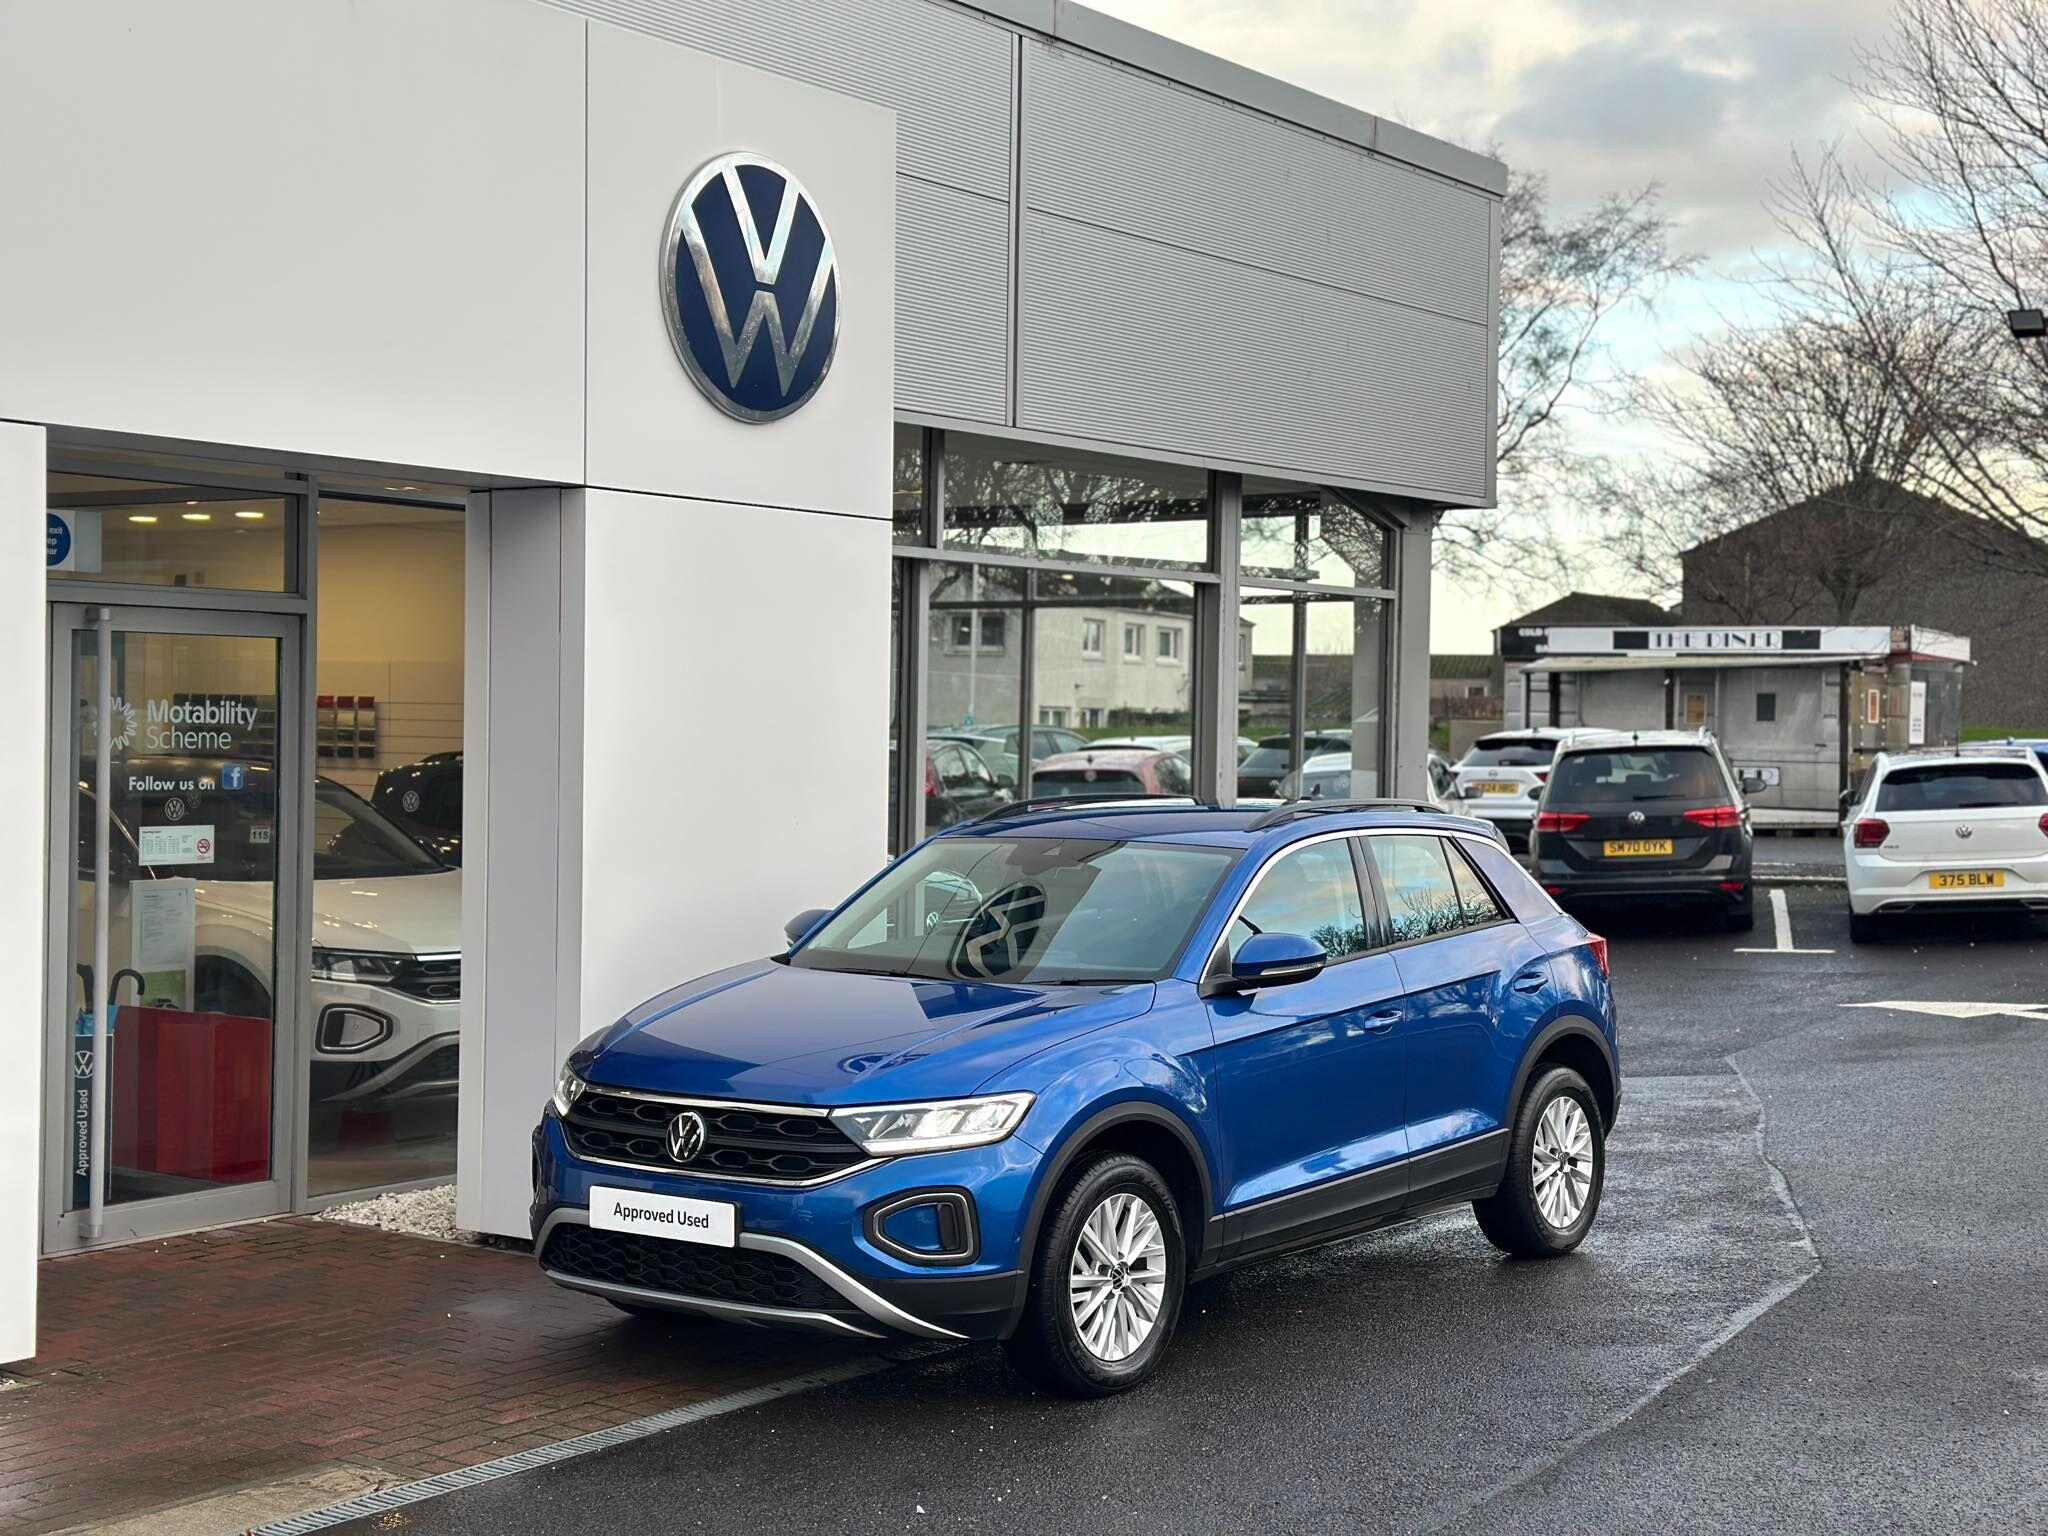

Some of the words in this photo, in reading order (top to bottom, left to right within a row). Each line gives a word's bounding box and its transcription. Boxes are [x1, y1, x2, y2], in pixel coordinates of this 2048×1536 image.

[659, 151, 842, 425] VW
[1706, 632, 1780, 648] DINER
[147, 699, 258, 731] Motability
[146, 725, 232, 749] Scheme
[128, 775, 175, 791] Follow
[180, 780, 194, 791] us
[198, 778, 216, 791] on
[252, 830, 269, 840] 115
[1938, 874, 1965, 887] 375
[1968, 873, 1994, 886] BLW
[77, 1089, 88, 1117] Used
[76, 1121, 89, 1176] Approved
[613, 1202, 674, 1223] Approved
[677, 1211, 709, 1229] Used
